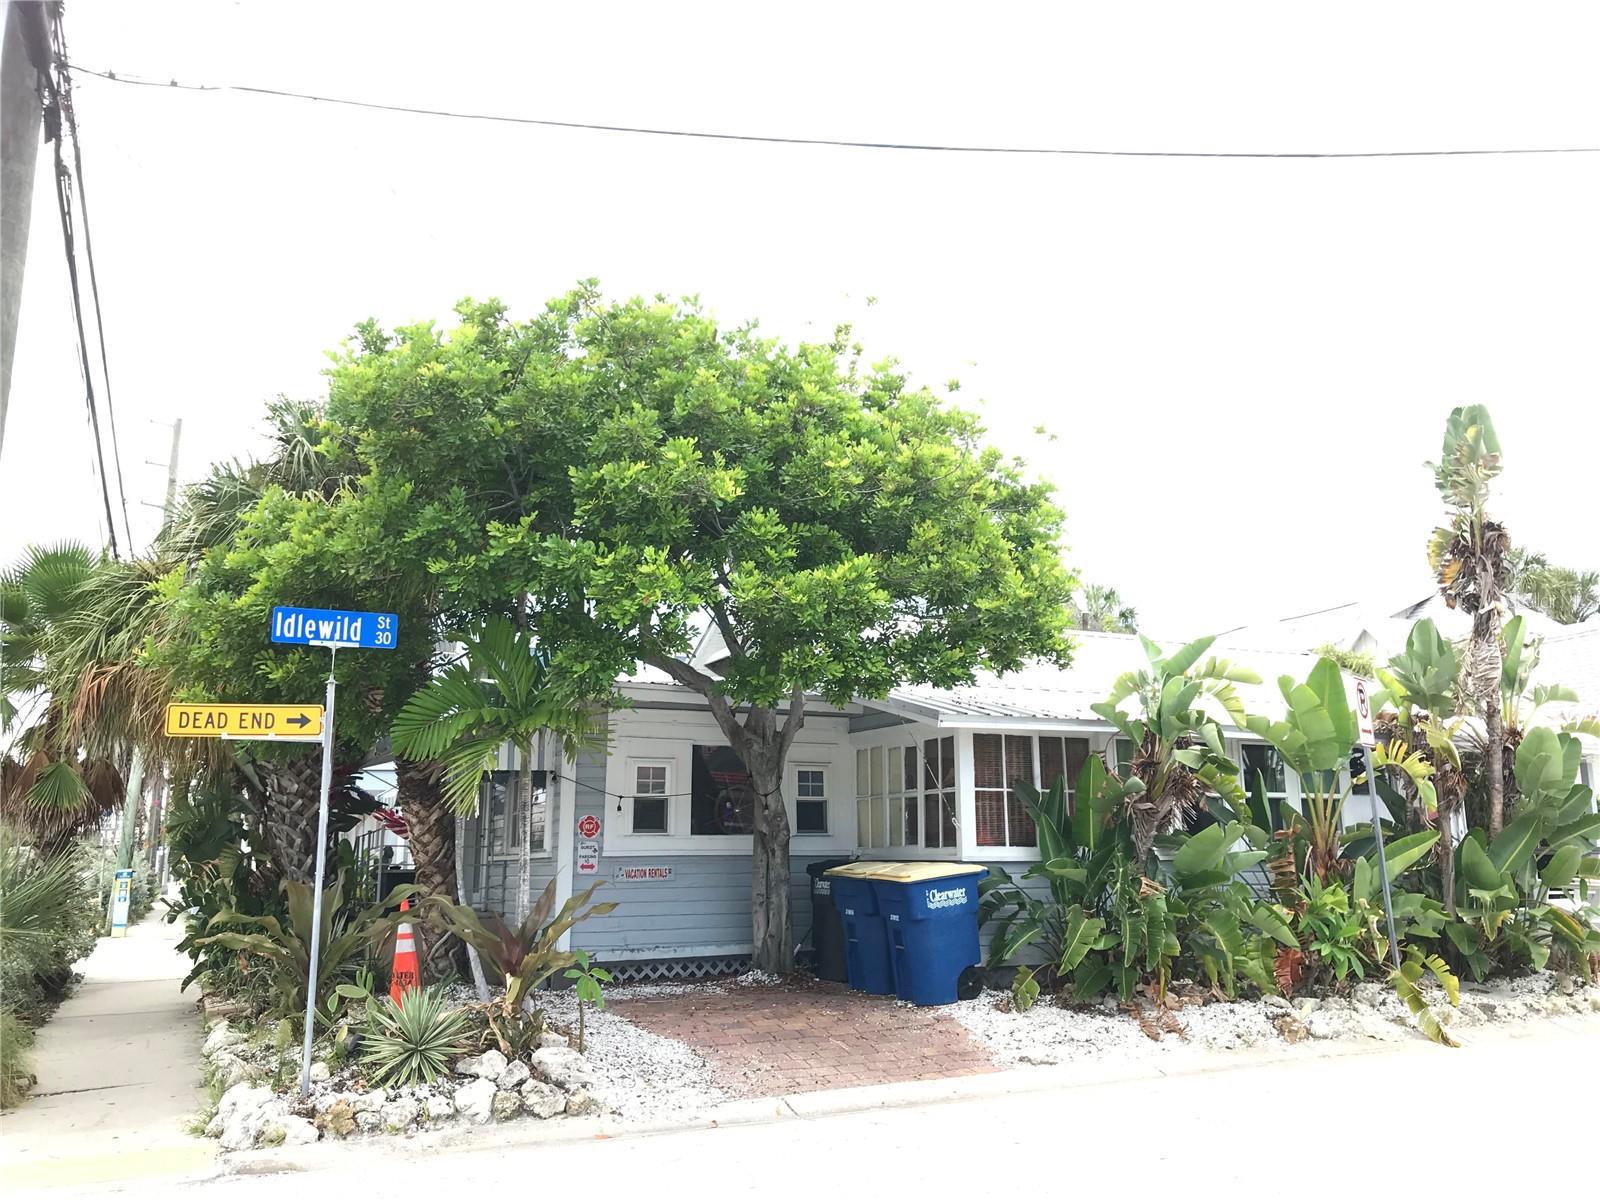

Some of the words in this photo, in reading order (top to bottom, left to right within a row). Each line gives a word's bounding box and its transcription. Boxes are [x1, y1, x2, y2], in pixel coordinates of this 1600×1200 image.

[276, 611, 362, 641] Idlewild
[377, 616, 391, 629] St
[374, 631, 392, 645] 30
[178, 711, 229, 729] DEAD
[239, 712, 275, 729] END
[624, 868, 647, 879] VACATION
[648, 868, 668, 878] RENTALS
[929, 887, 966, 902] Clearwater
